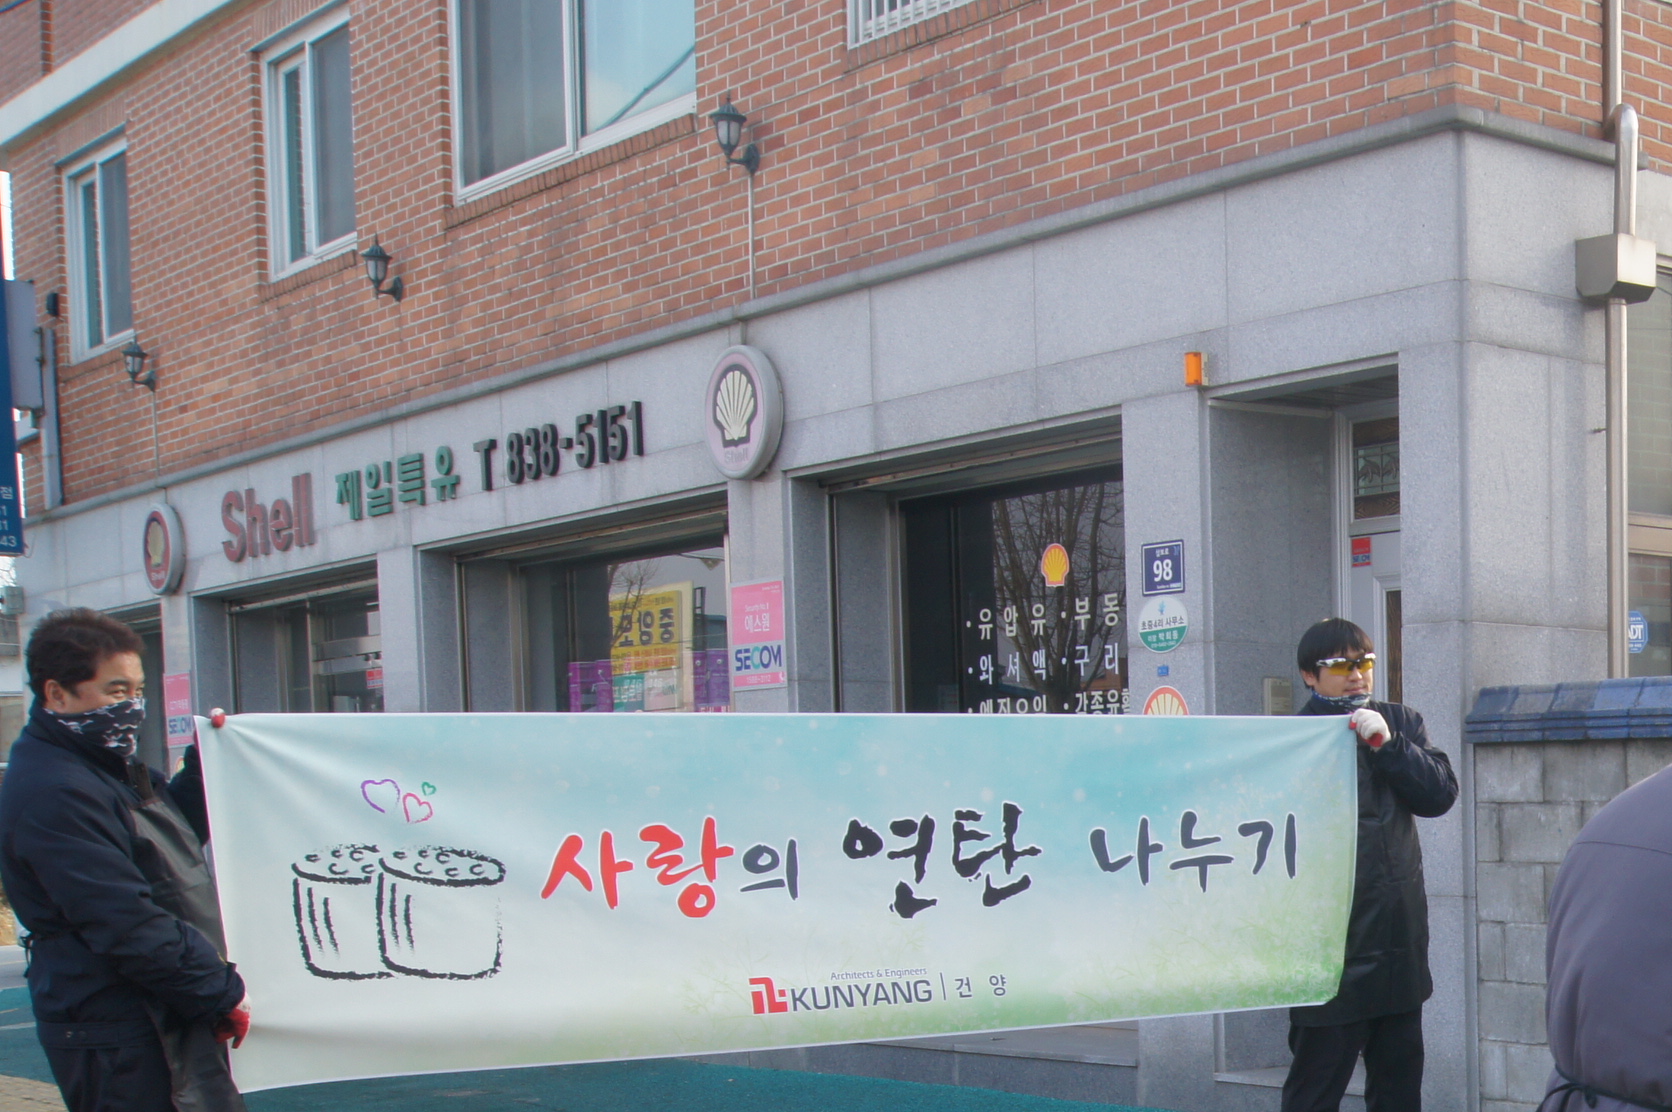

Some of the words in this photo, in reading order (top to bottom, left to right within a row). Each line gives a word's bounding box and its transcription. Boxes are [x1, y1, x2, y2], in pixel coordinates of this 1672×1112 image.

[221, 472, 315, 563] Shell
[335, 446, 461, 521] 제일특유
[473, 439, 497, 491] T
[506, 401, 644, 485] 838-5151
[1153, 558, 1173, 582] 98
[744, 613, 770, 632] 에스원
[735, 645, 782, 671] SECOM
[541, 815, 799, 918] 사랑의
[842, 801, 1042, 919] 연탄
[1089, 810, 1298, 893] 나누기
[830, 969, 875, 981] Architects
[876, 969, 883, 978] &
[885, 967, 928, 979] Engineers
[790, 979, 933, 1012] KUNYANG
